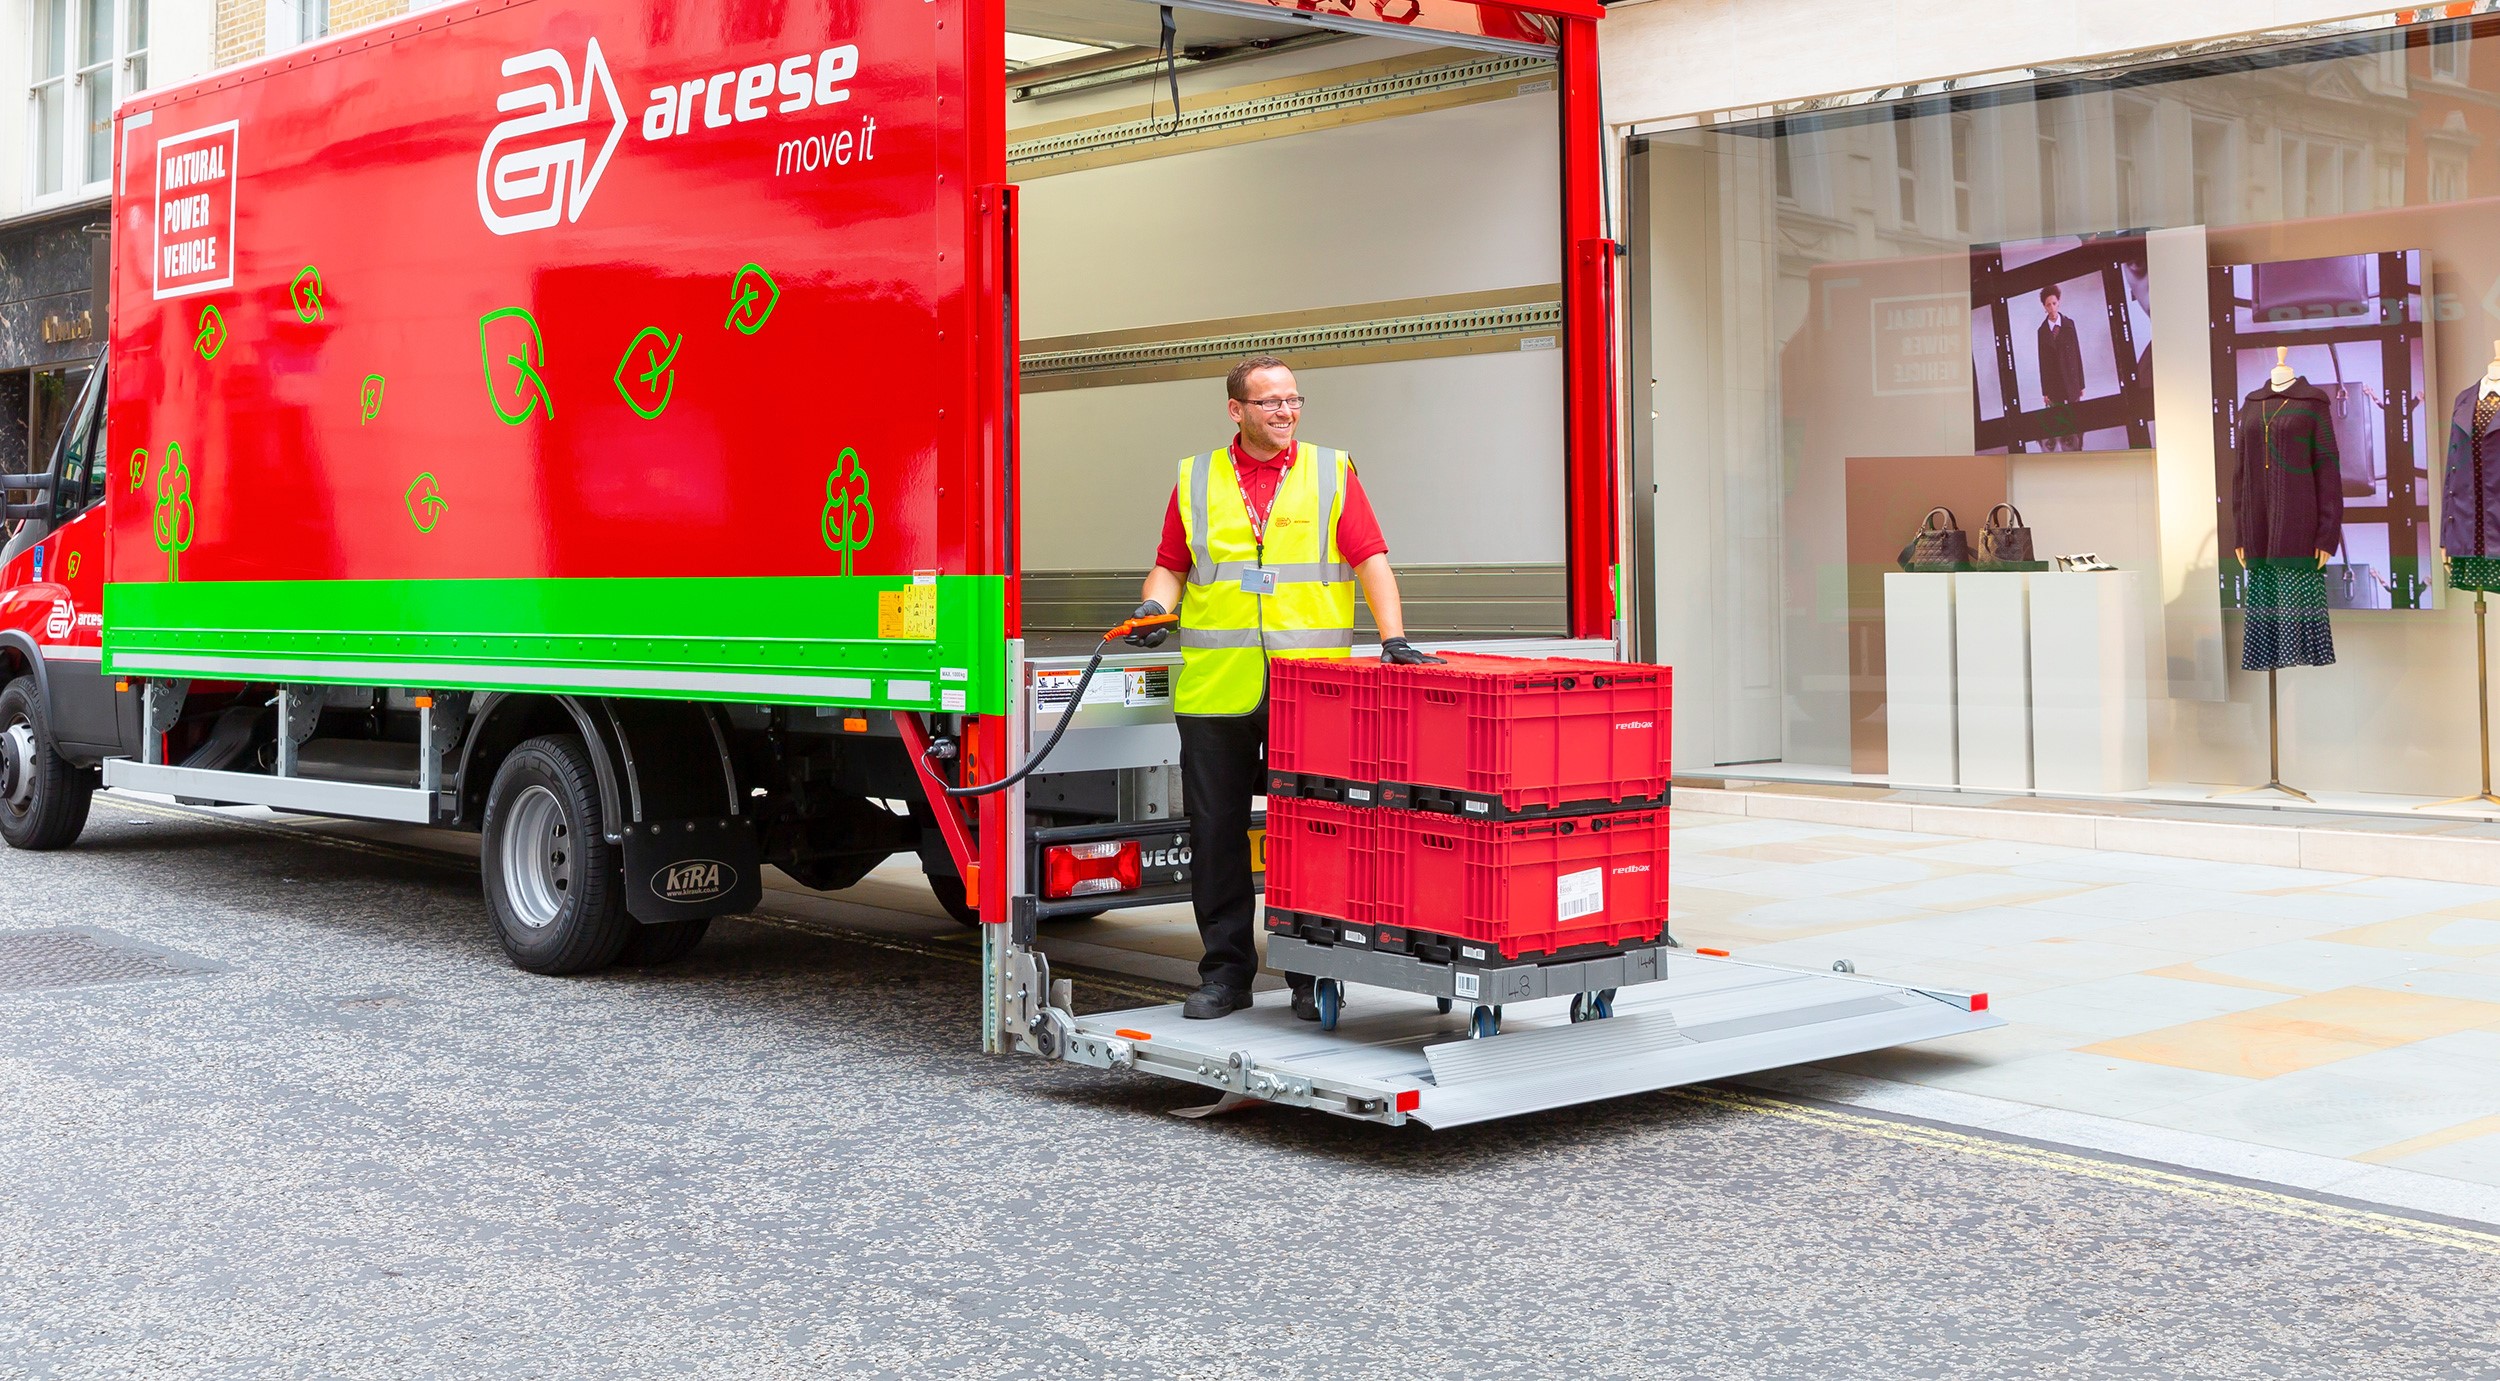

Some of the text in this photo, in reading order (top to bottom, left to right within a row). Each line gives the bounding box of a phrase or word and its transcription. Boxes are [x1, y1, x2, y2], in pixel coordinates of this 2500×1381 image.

[642, 44, 859, 141] arcese
[775, 115, 877, 177] move it
[165, 145, 225, 190] NATURAL
[164, 193, 209, 235] POWER
[164, 236, 216, 279] VEHICLE
[77, 613, 103, 626] arces
[1615, 721, 1654, 730] redbox
[1141, 846, 1193, 868] VECO
[1612, 865, 1651, 875] redbox
